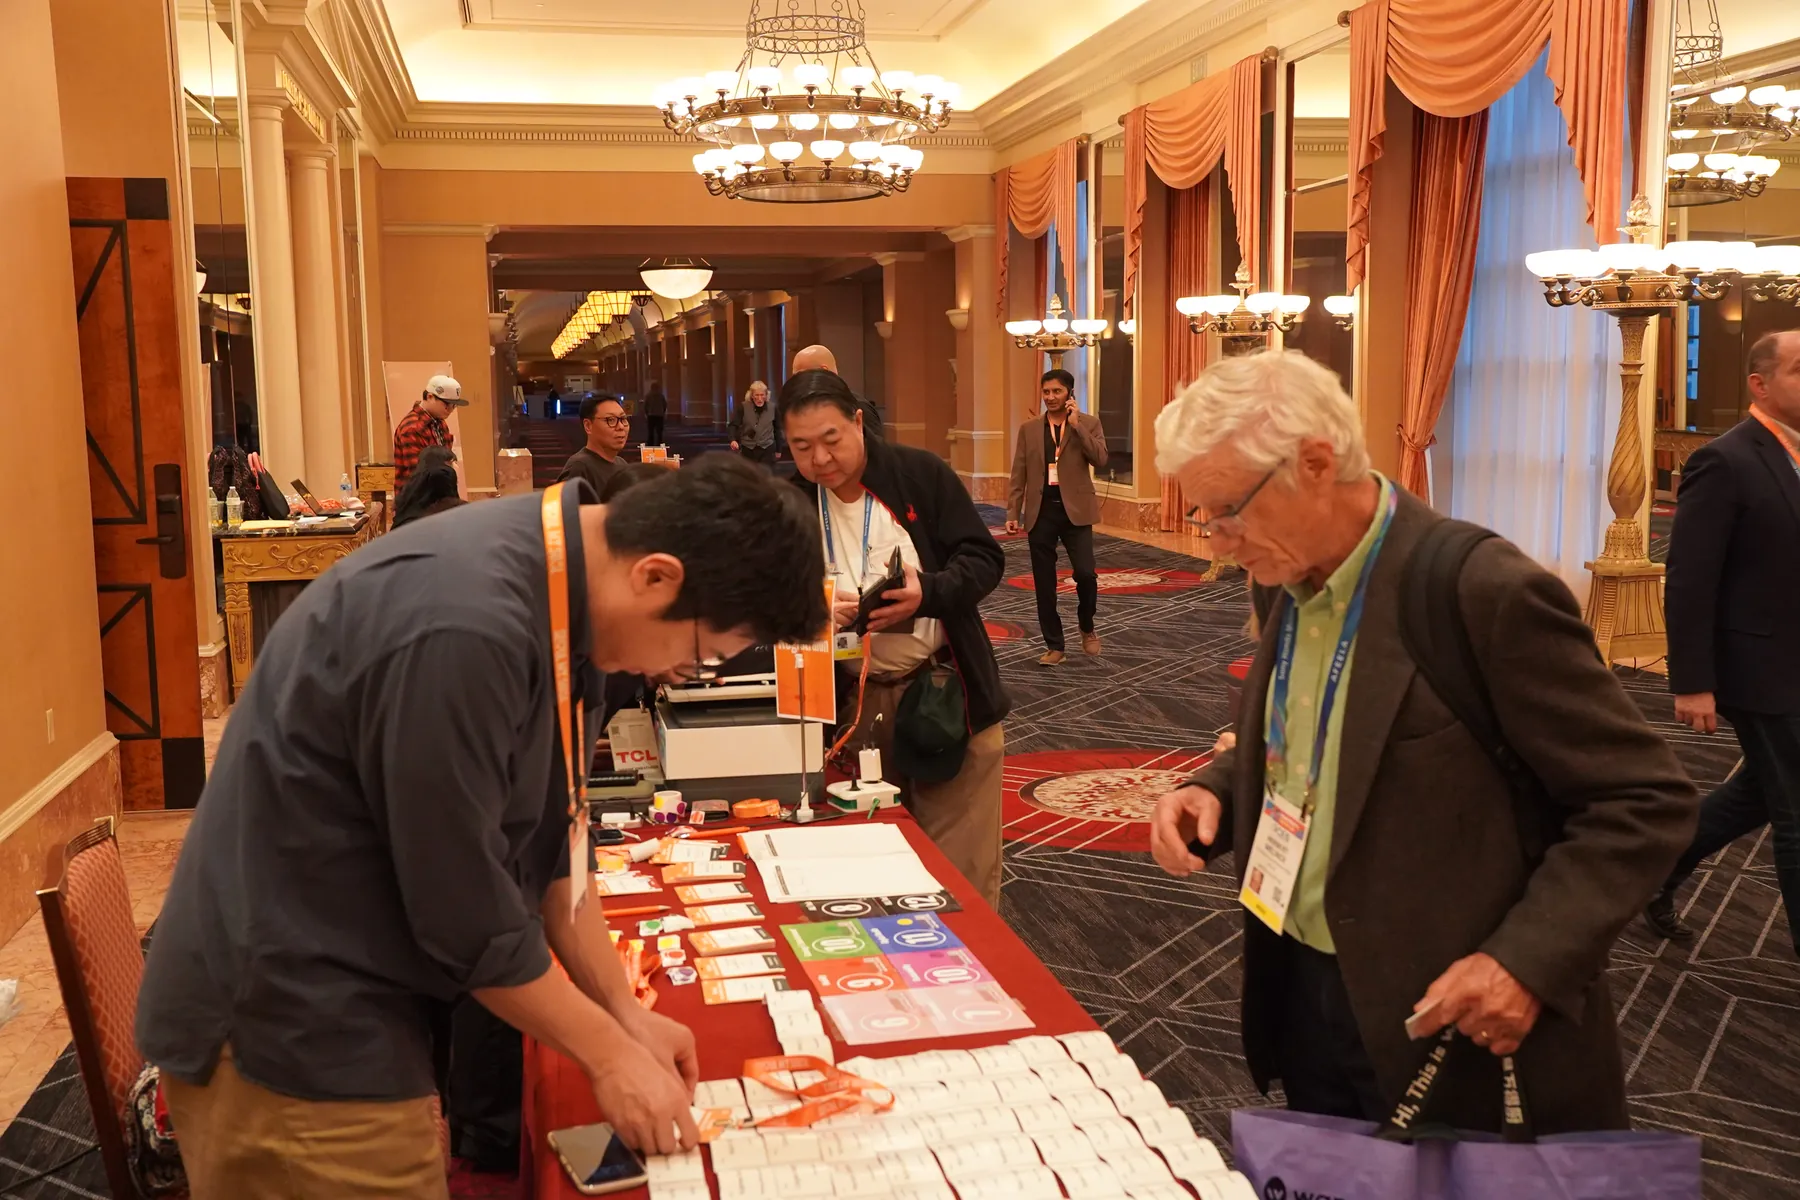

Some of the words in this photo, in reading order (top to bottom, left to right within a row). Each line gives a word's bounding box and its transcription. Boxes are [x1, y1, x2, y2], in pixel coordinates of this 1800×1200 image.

[1330, 640, 1349, 684] AFEELA
[615, 749, 657, 764] TCL
[830, 903, 863, 913] 8
[904, 894, 940, 909] 12
[820, 937, 857, 951] 10
[902, 932, 939, 945] 11
[932, 967, 972, 984] 10
[1391, 1103, 1420, 1129] Hi,
[1406, 1062, 1438, 1099] This
[1428, 1045, 1446, 1062] is
